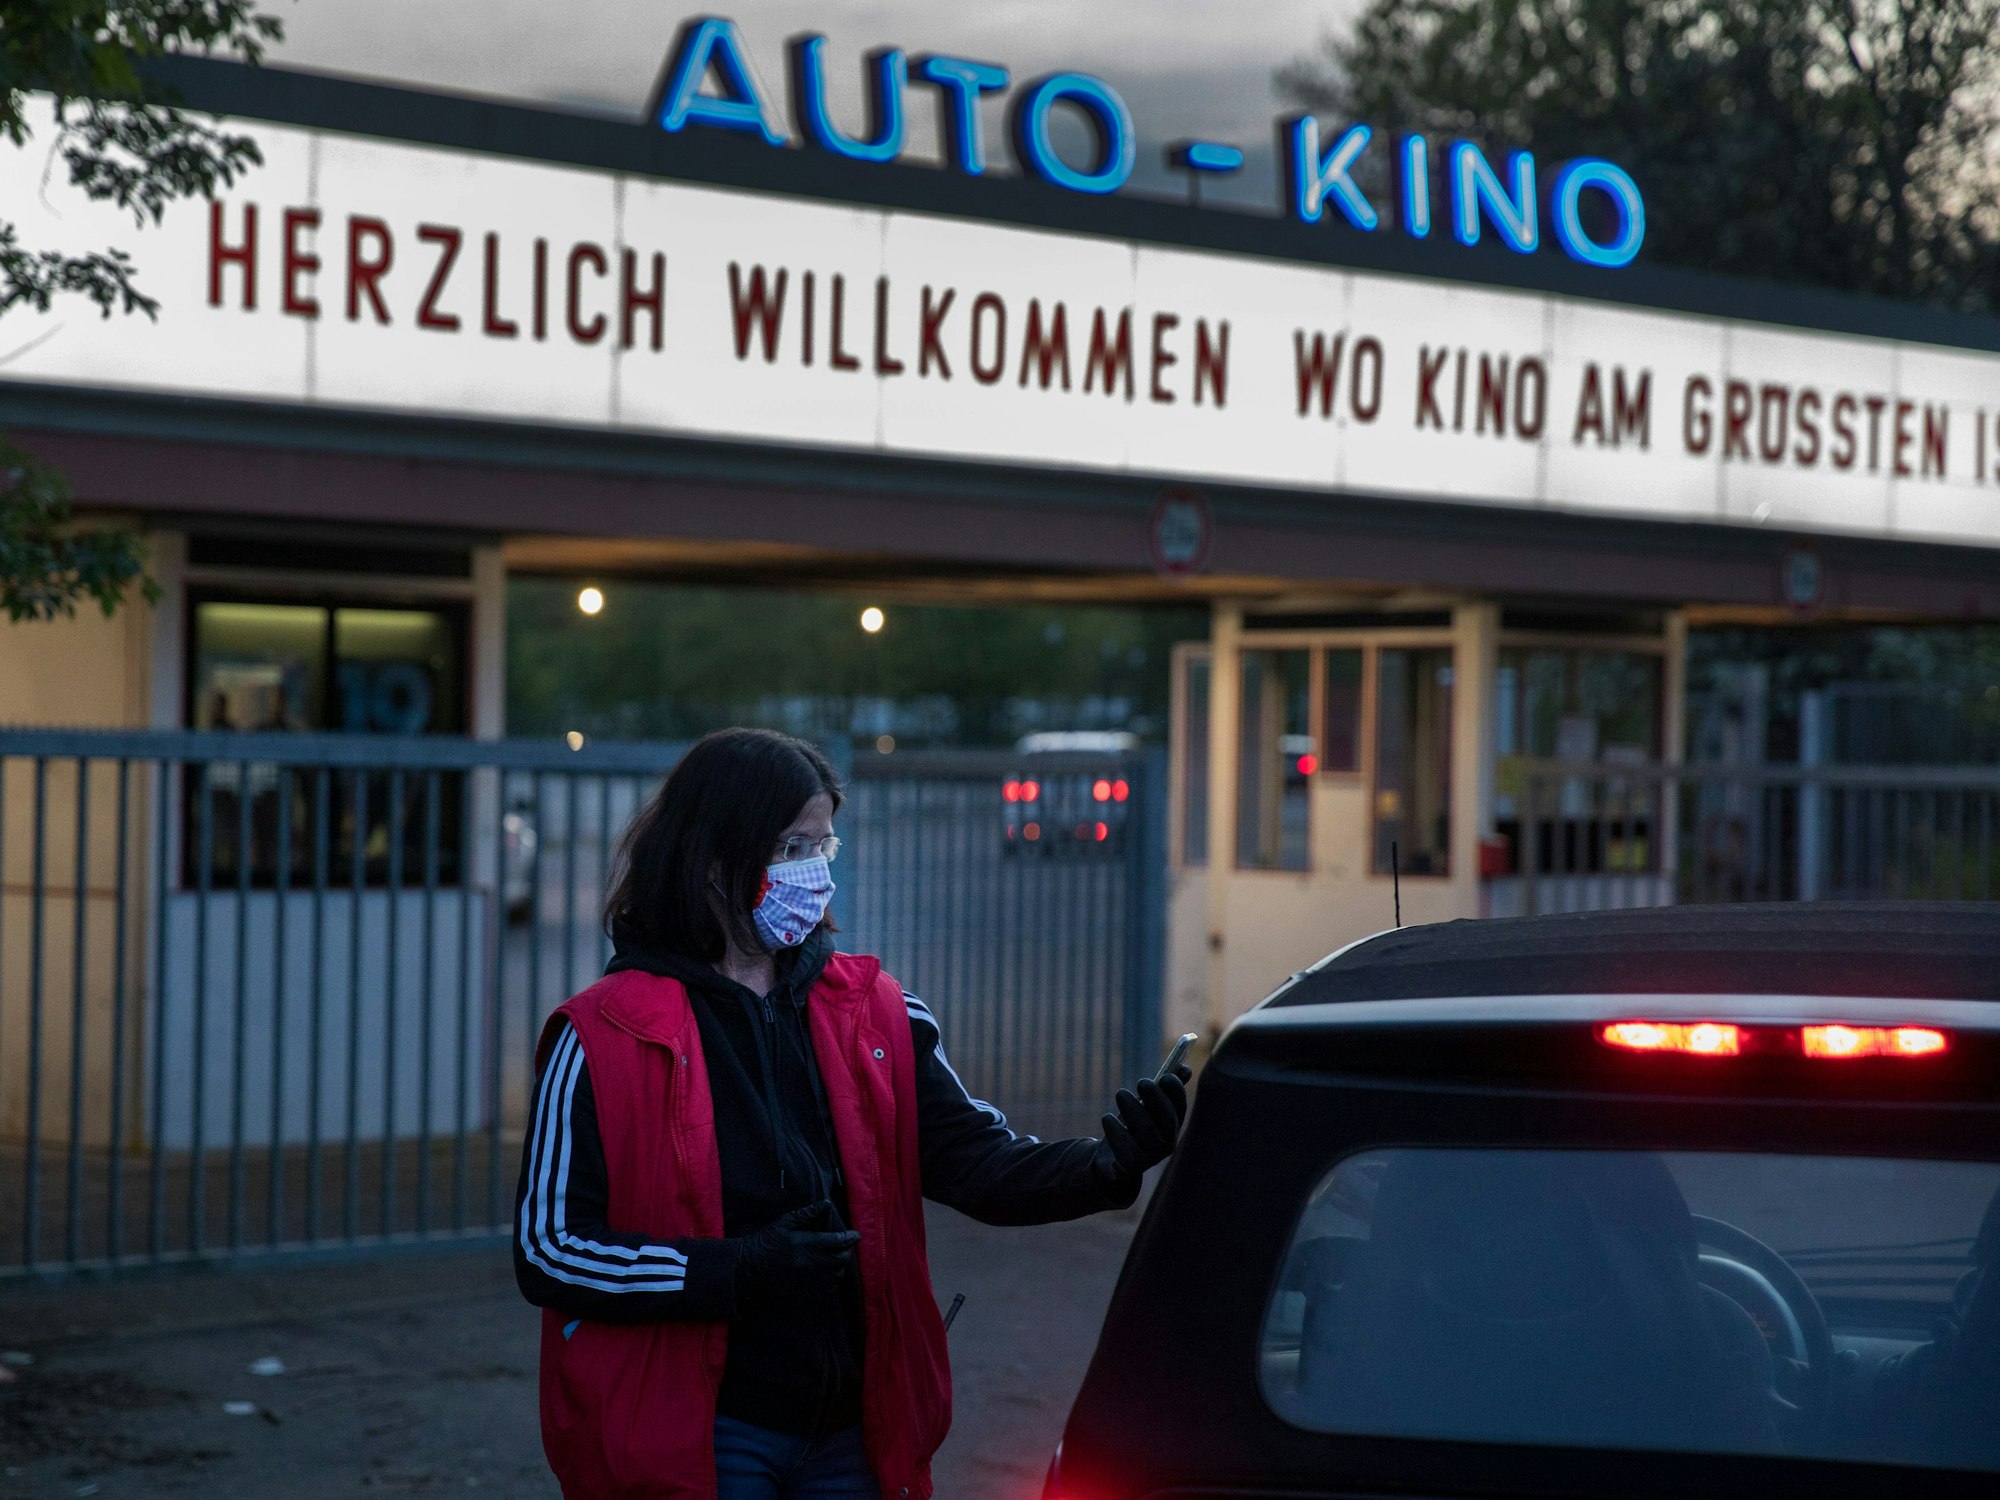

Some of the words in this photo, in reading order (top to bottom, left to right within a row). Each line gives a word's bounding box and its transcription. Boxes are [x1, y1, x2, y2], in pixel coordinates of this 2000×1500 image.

[658, 17, 1137, 195] AUTO
[1293, 114, 1646, 270] KINO
[207, 199, 667, 354] HERZLICH
[727, 261, 1231, 409] WILLKOMMEN
[1294, 329, 1385, 425] WO
[1416, 344, 1549, 443] KINO
[1573, 362, 1652, 451] AM
